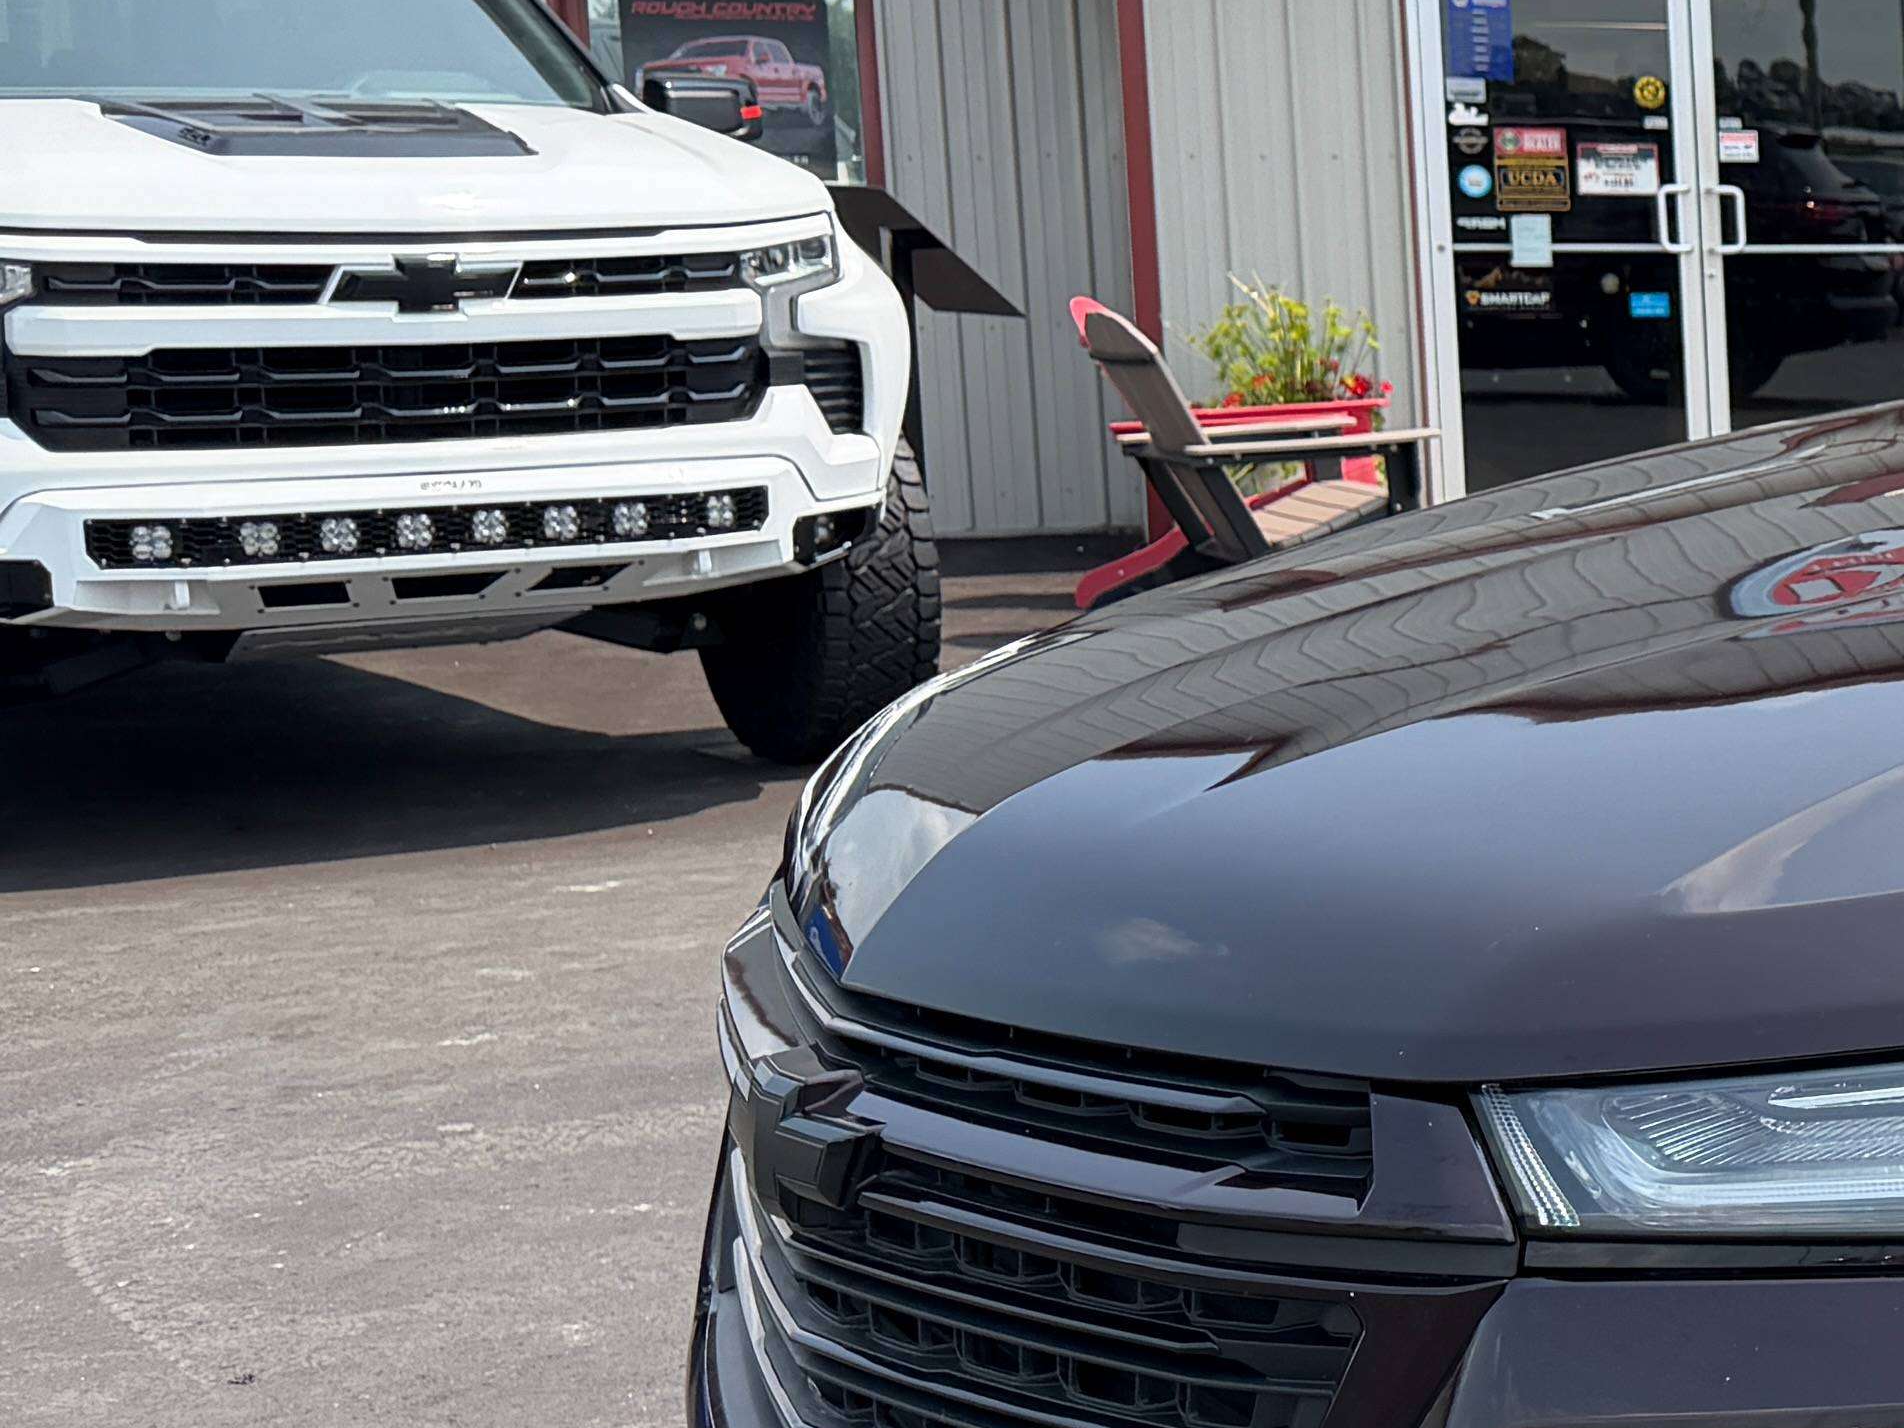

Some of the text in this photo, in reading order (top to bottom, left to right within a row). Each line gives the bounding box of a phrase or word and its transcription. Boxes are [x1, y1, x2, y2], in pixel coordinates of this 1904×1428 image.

[631, 0, 707, 16] ROUGH
[711, 1, 817, 18] COUNTRY
[1507, 170, 1557, 187] UCDA
